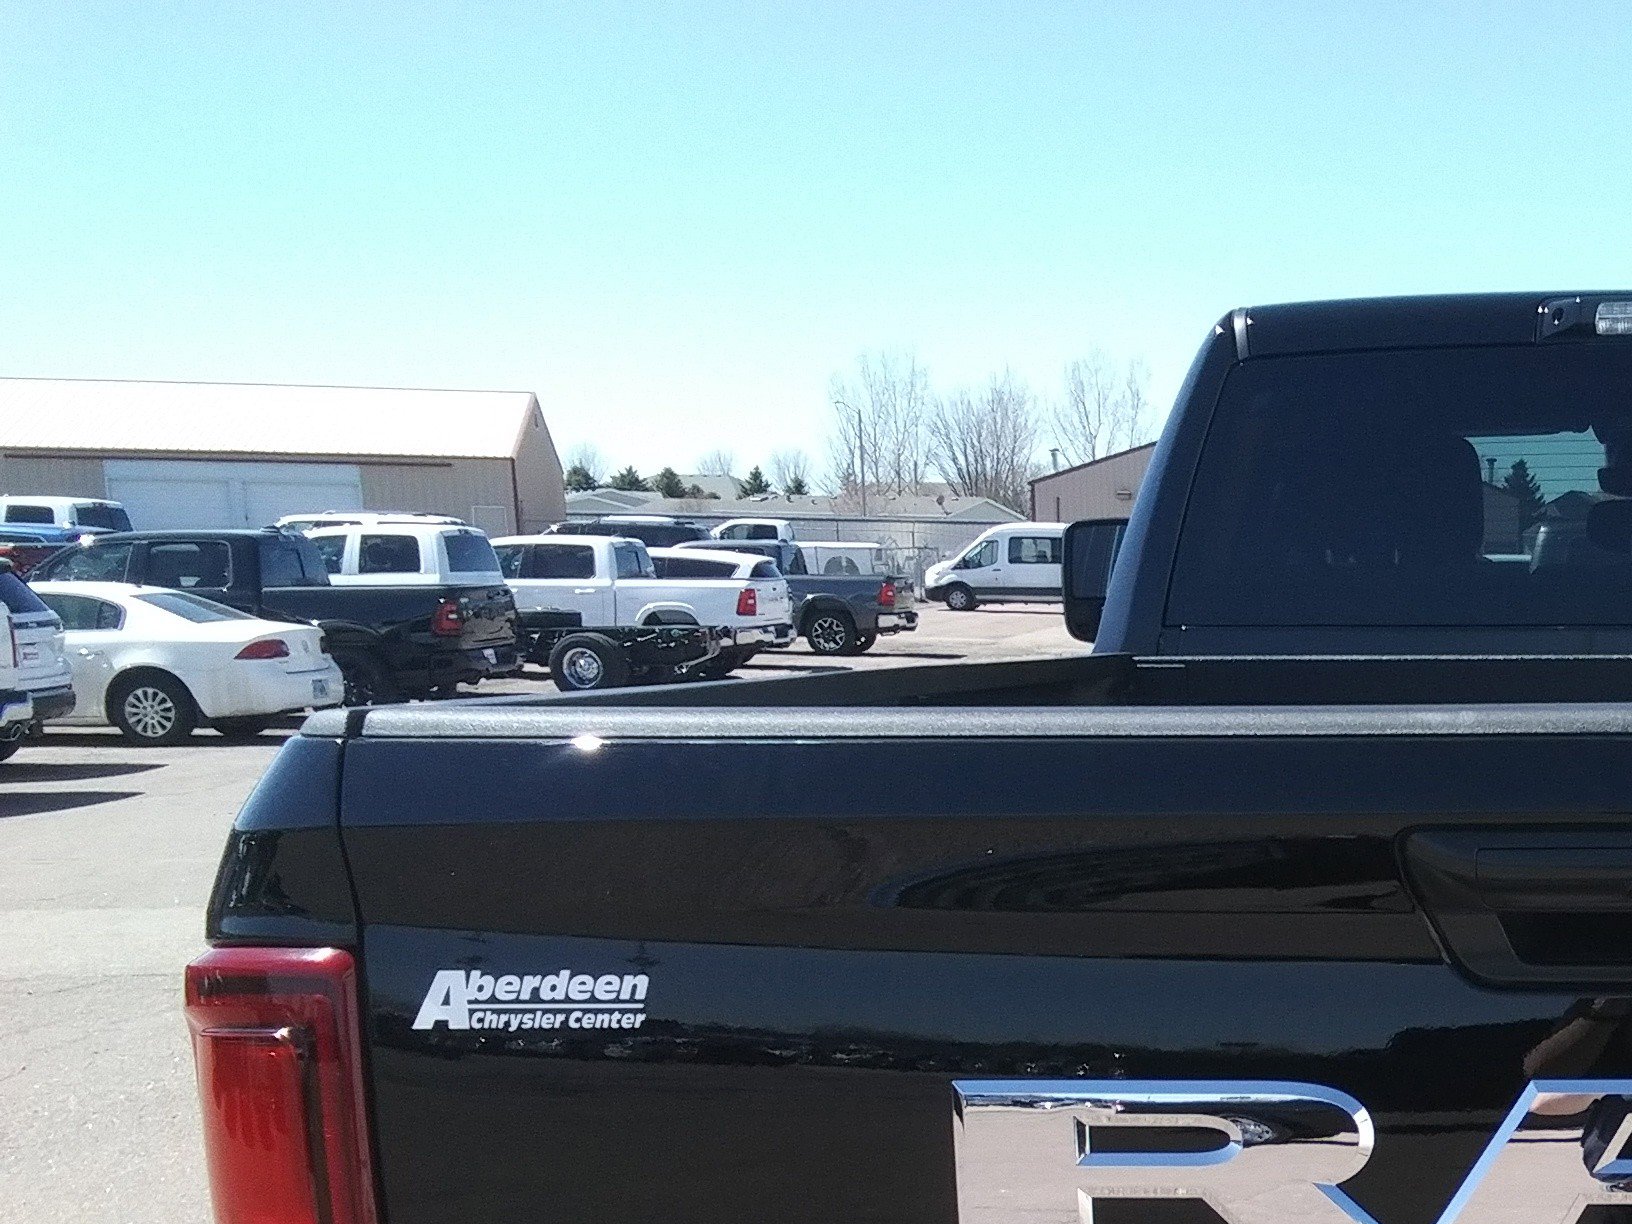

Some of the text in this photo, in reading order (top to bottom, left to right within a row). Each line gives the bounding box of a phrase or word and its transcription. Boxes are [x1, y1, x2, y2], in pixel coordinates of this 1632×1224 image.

[411, 969, 649, 1030] Aberdeen
[470, 1010, 647, 1032] Chrysler Center
